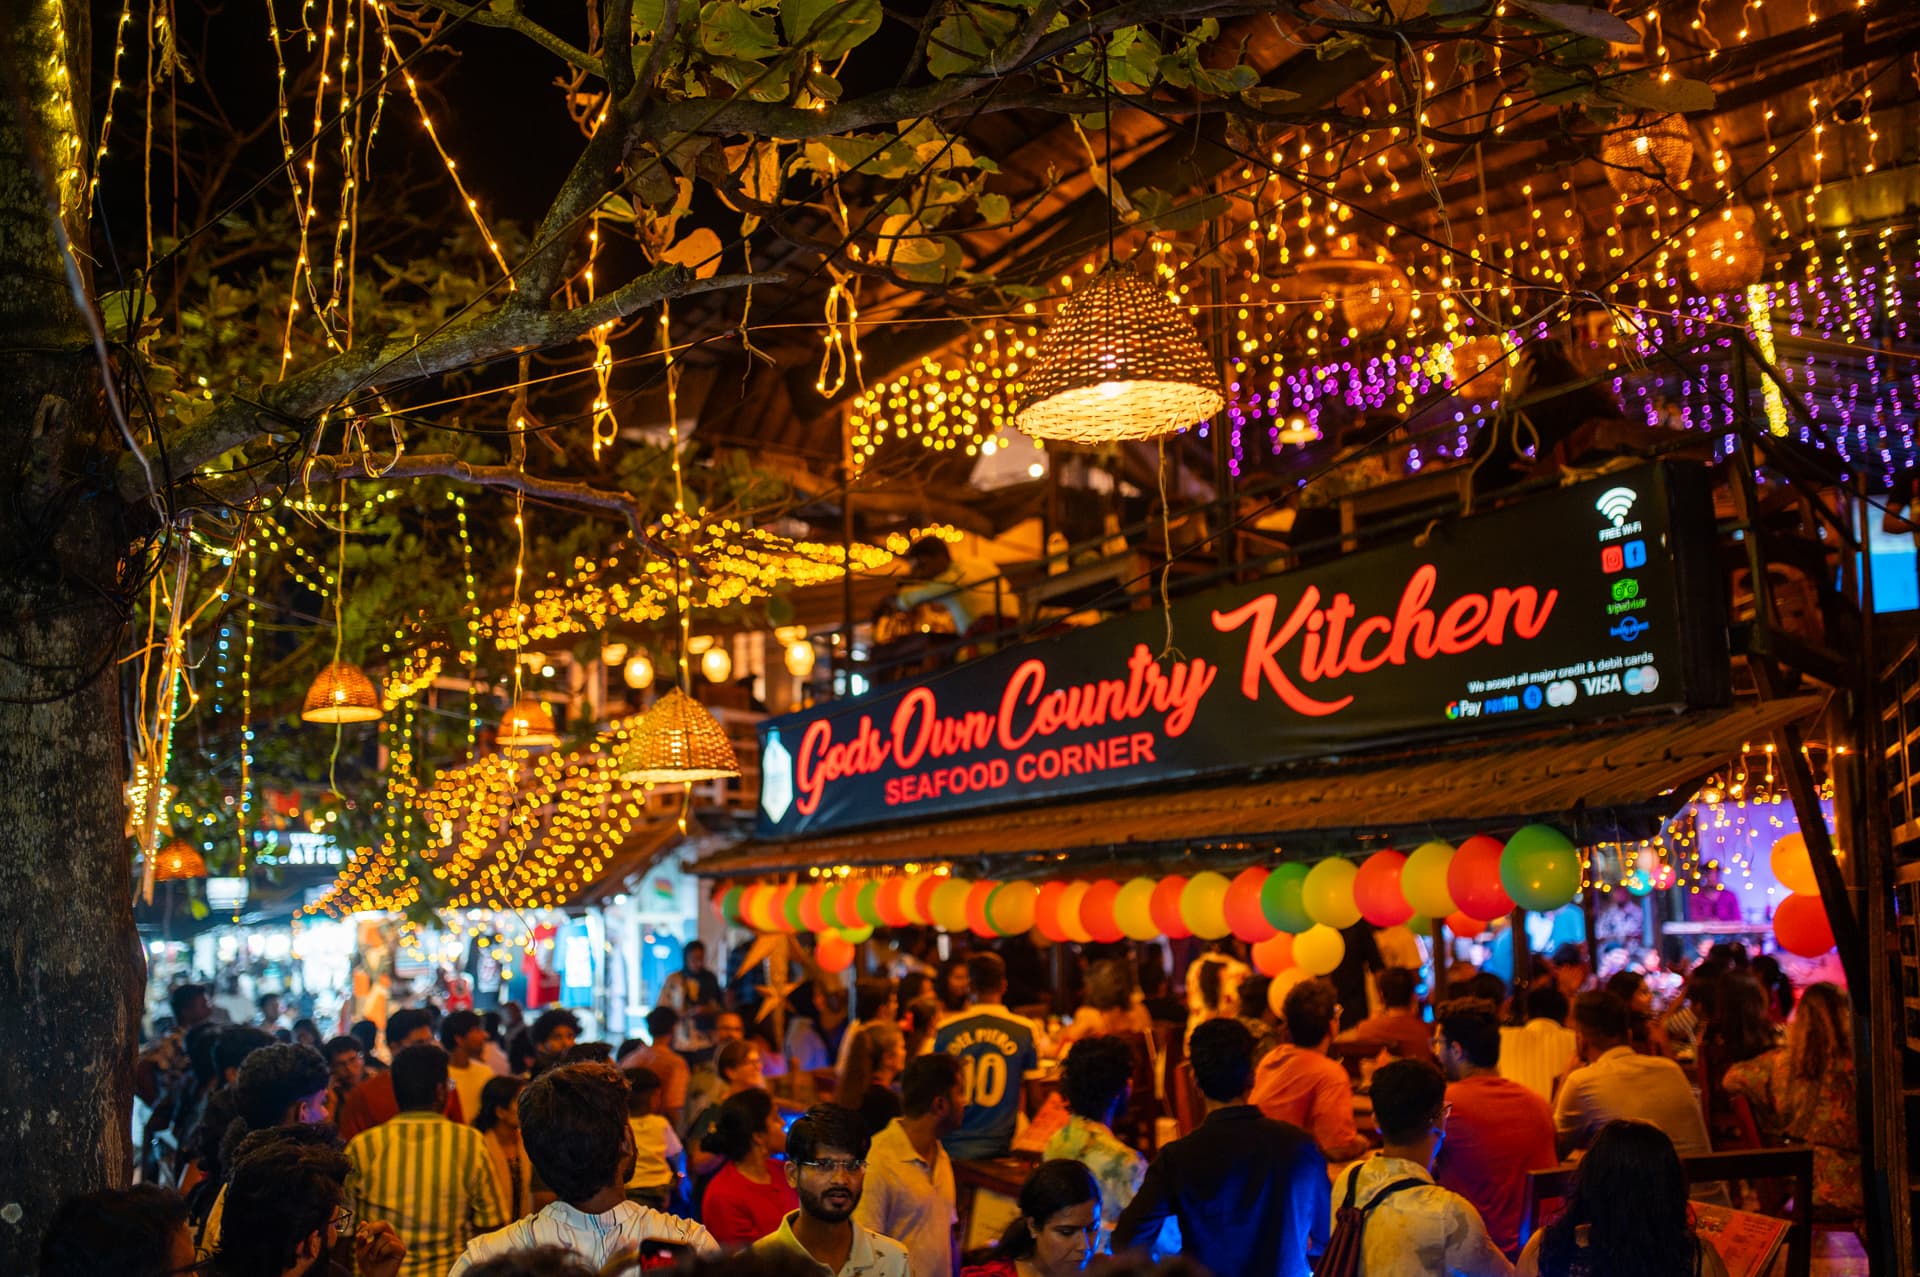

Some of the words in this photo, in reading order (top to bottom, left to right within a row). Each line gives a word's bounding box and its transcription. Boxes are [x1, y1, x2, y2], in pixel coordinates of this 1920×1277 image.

[1598, 527, 1622, 542] FREE
[796, 719, 891, 816] Gods
[891, 686, 996, 770] Own
[997, 643, 1218, 751] Country
[1211, 563, 1559, 717] Kitchen
[1467, 680, 1485, 694] We
[1485, 674, 1516, 692] accept
[1516, 671, 1529, 686] all
[1529, 667, 1557, 684] major
[1557, 662, 1586, 679] credit
[1586, 659, 1596, 674] &
[1597, 655, 1623, 671] debit
[1623, 650, 1654, 667] cards
[1579, 672, 1622, 697] VISA
[884, 758, 1010, 807] SEAFOOD
[1015, 731, 1156, 784] CORNER
[947, 1031, 974, 1056] DEL
[963, 1053, 1007, 1106] 10
